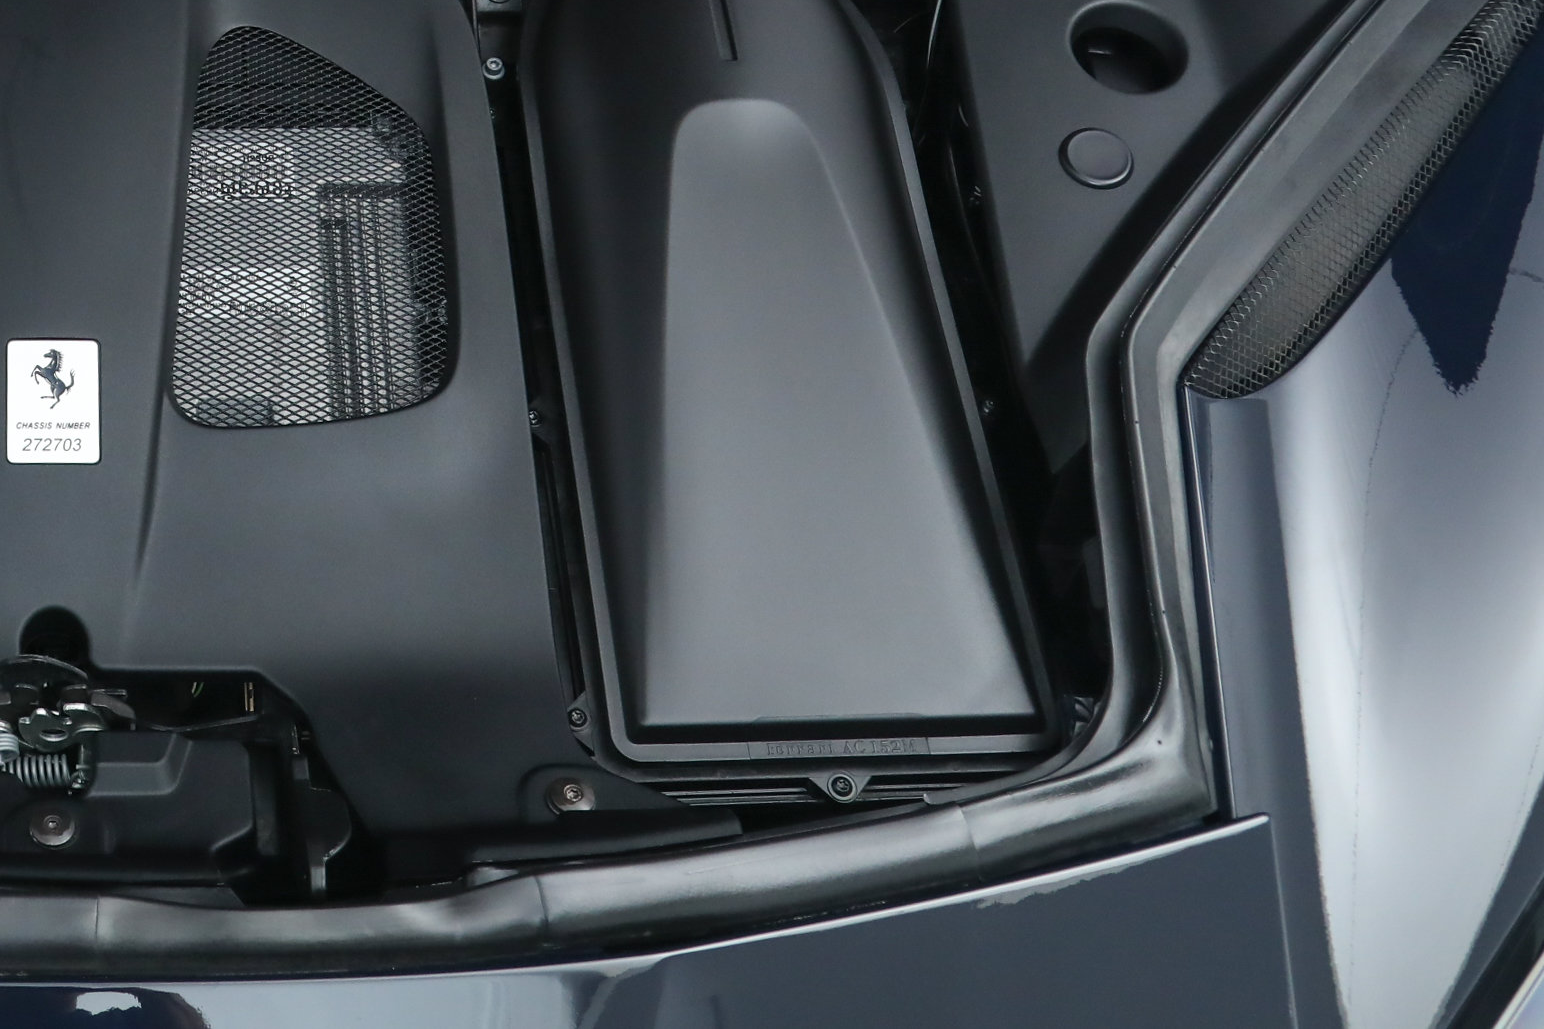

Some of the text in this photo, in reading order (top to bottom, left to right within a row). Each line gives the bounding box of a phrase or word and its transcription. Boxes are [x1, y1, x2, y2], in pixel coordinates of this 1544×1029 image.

[16, 422, 53, 430] CHASSIS
[22, 438, 82, 451] 272703
[767, 742, 833, 755] Ferrari
